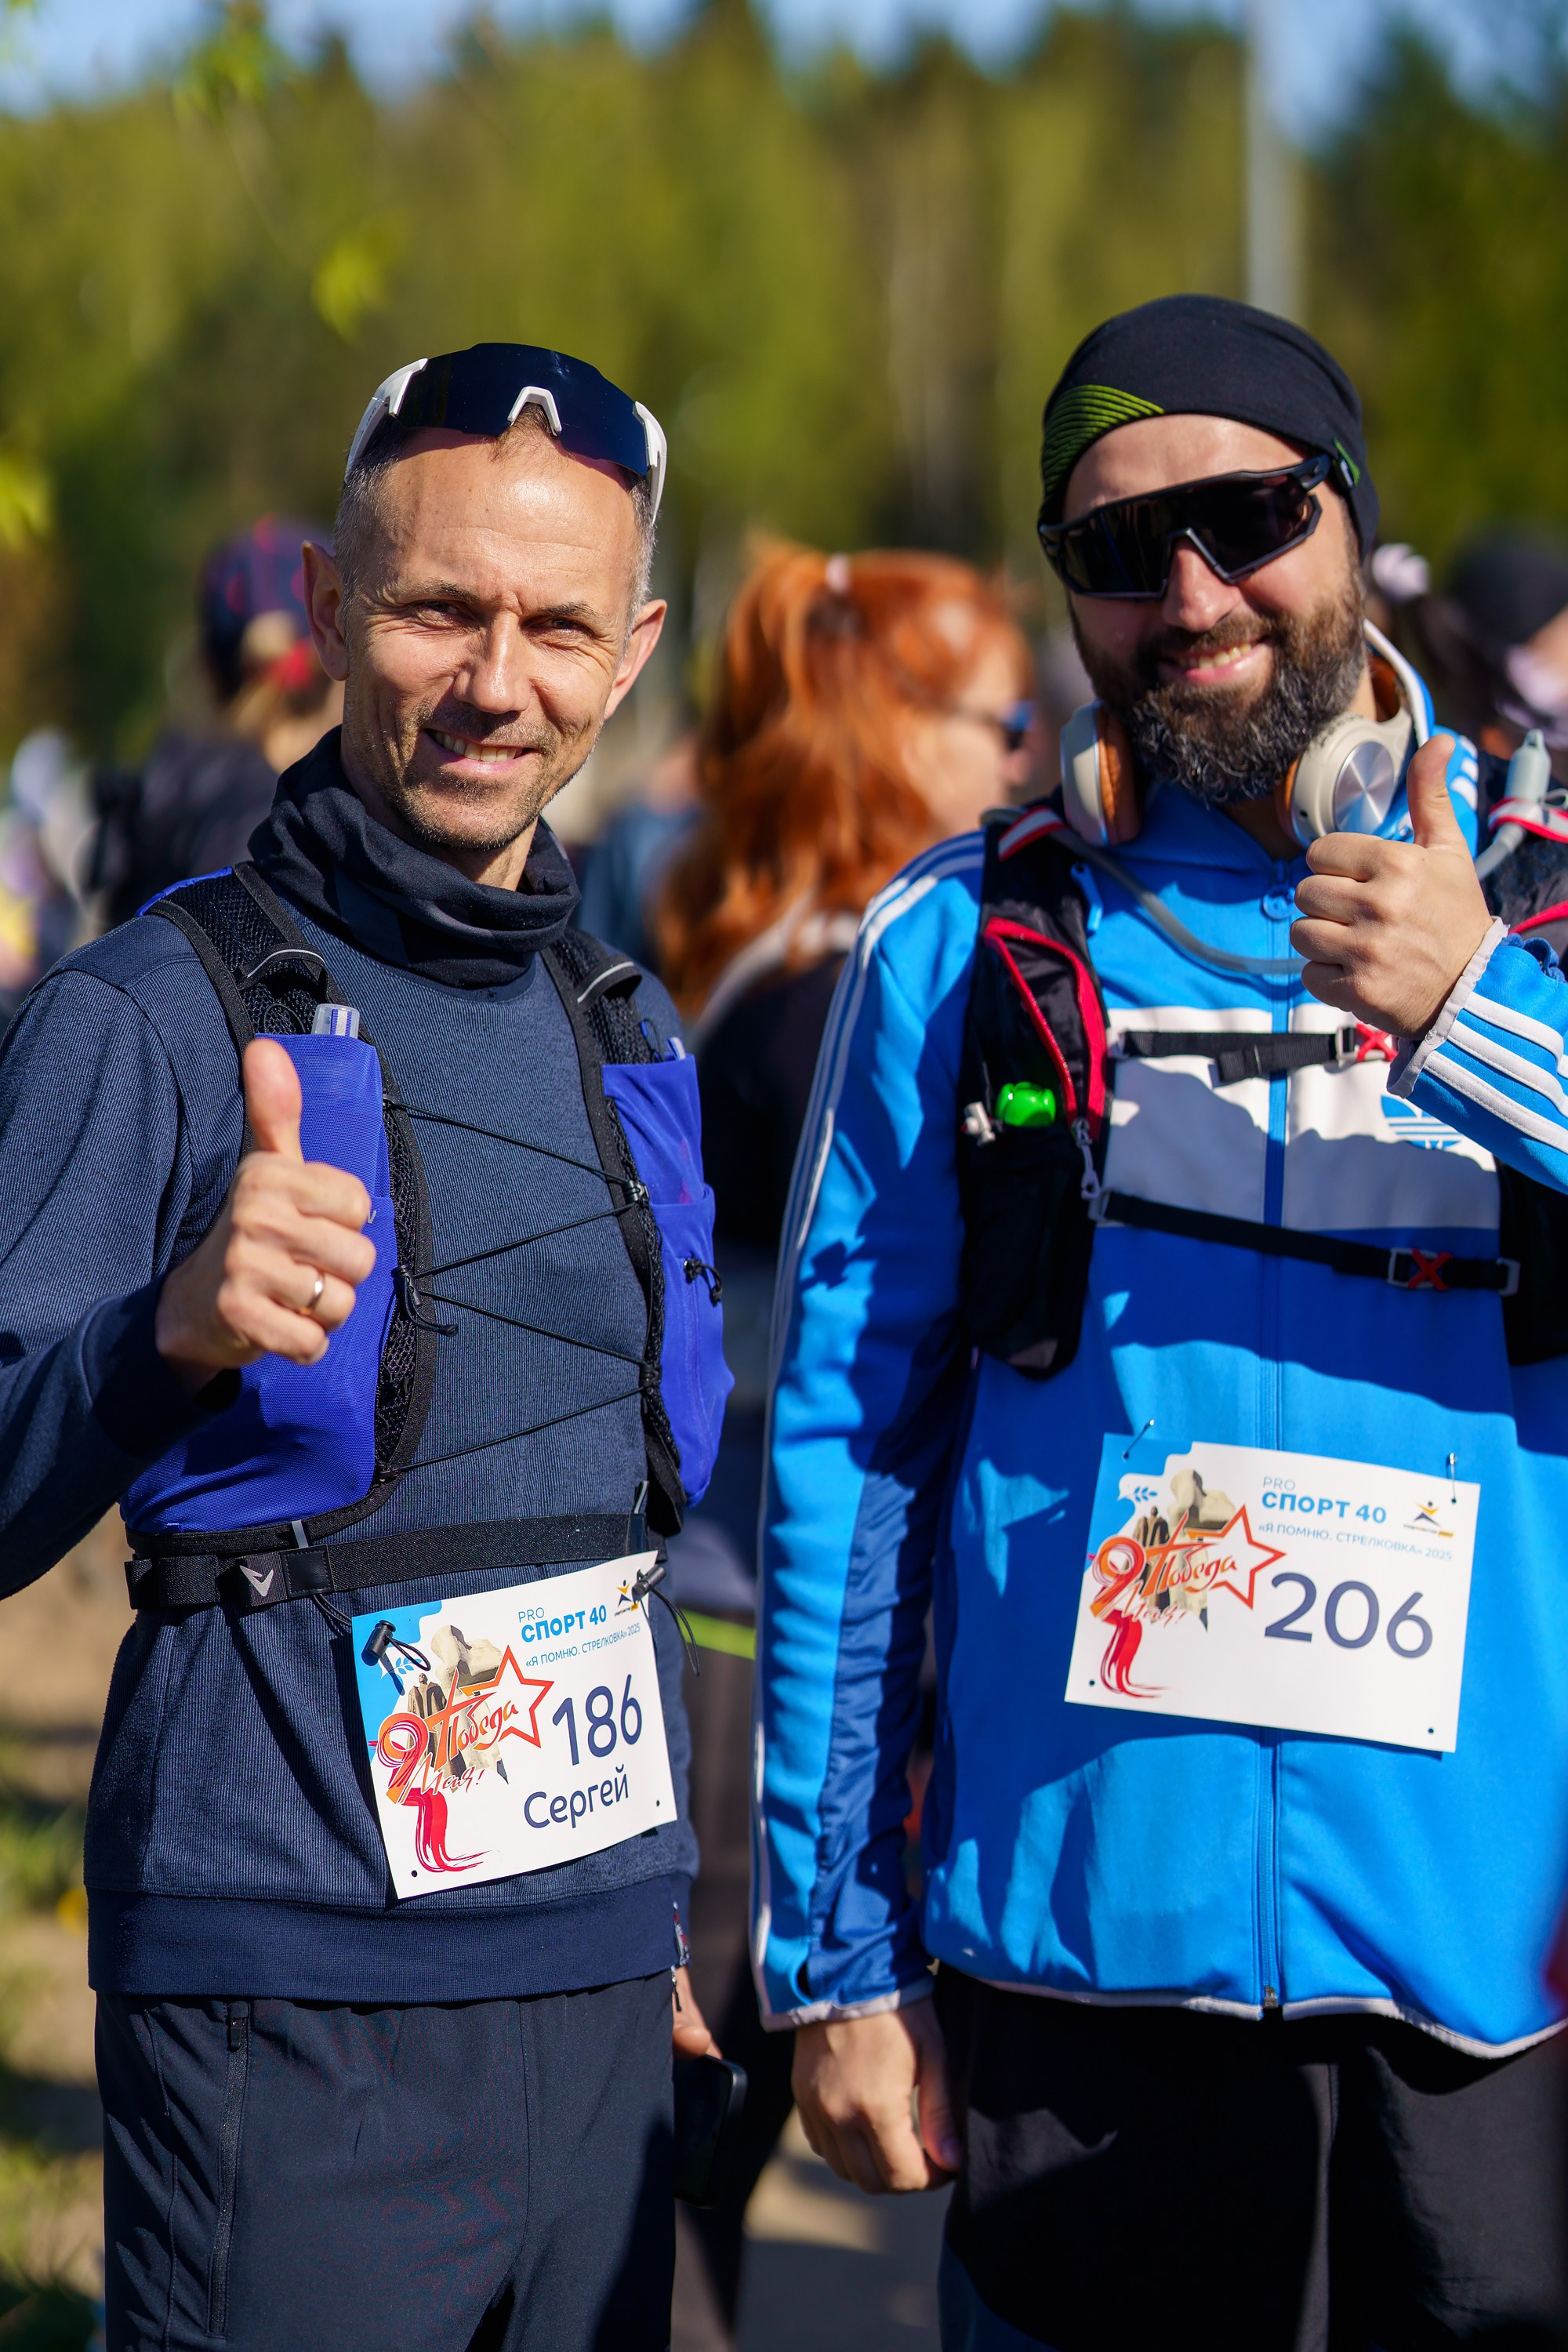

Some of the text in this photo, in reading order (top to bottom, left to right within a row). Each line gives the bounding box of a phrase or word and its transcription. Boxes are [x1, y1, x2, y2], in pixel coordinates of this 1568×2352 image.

[1263, 1476, 1296, 1491] PRO
[1261, 1492, 1387, 1524] СПОРТ 40
[1425, 1547, 1453, 1561] 2025
[518, 1607, 545, 1623] PRO
[521, 1610, 586, 1642] СПОРТ
[590, 1605, 607, 1625] 40
[627, 1622, 641, 1636] 2025
[1264, 1572, 1433, 1659] 206
[552, 1674, 642, 1766] 186
[524, 1764, 629, 1828] Сергей
